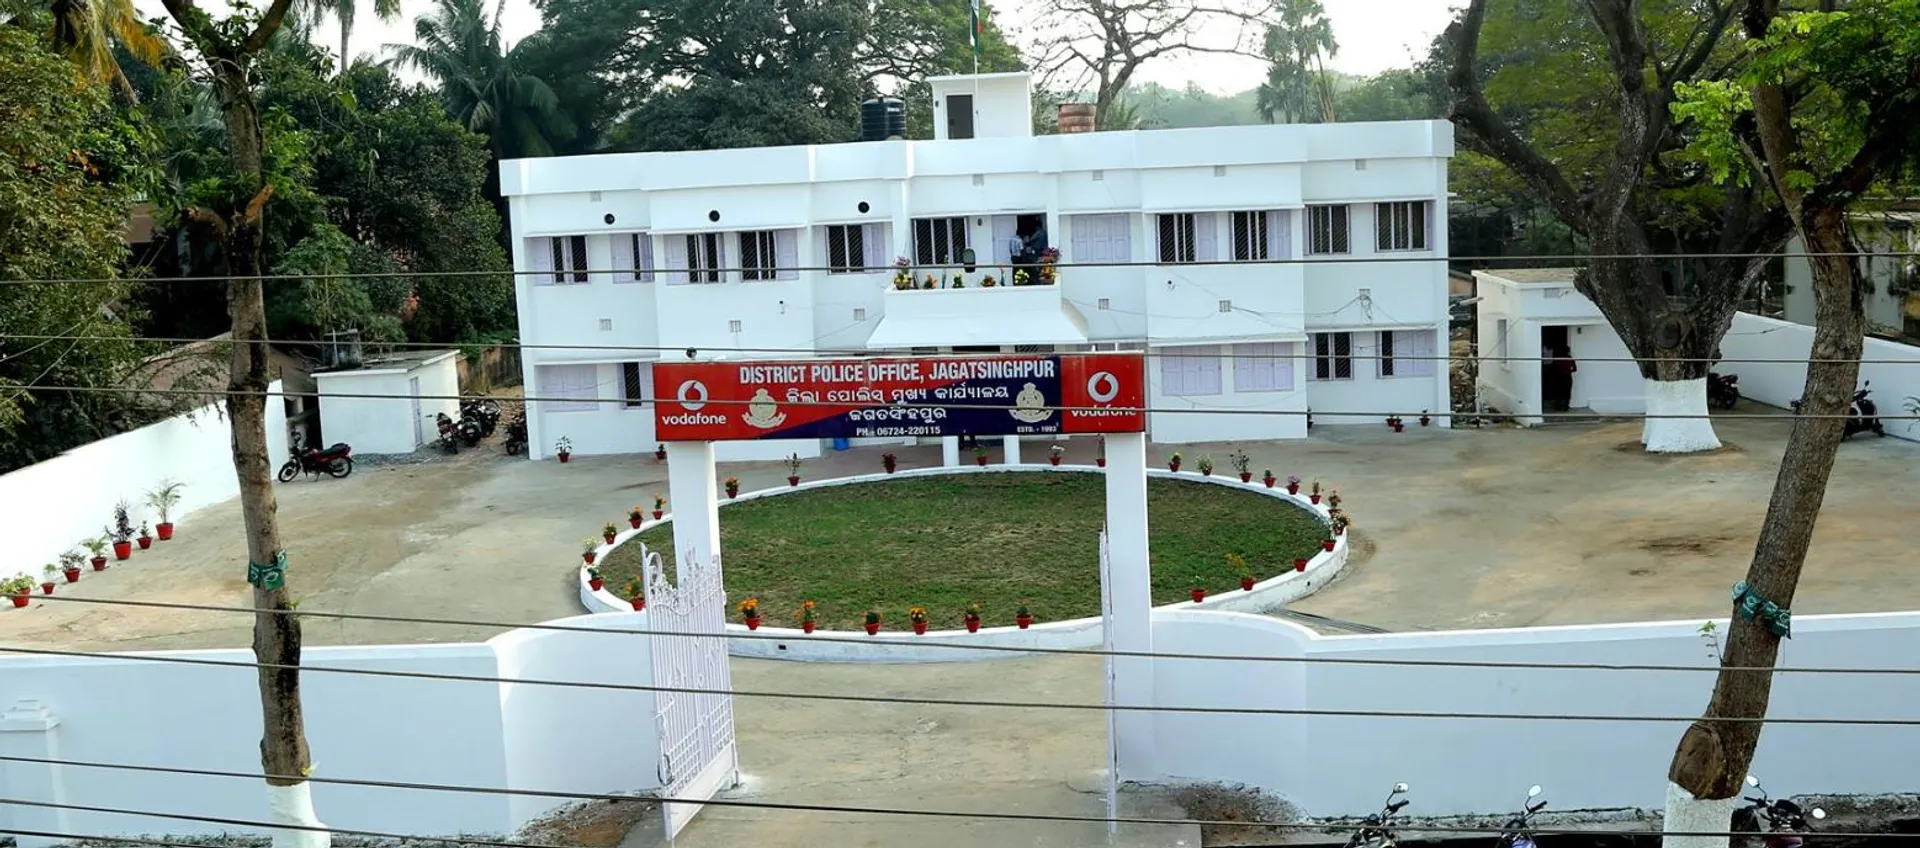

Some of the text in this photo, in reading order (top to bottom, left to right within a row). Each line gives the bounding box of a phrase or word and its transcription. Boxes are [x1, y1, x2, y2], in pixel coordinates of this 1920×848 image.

[740, 360, 1055, 384] DISTRICT POLICE OFFICE, JAGATSINGHPUR
[662, 412, 727, 425] vodafone
[877, 425, 942, 436] 06724-220115
